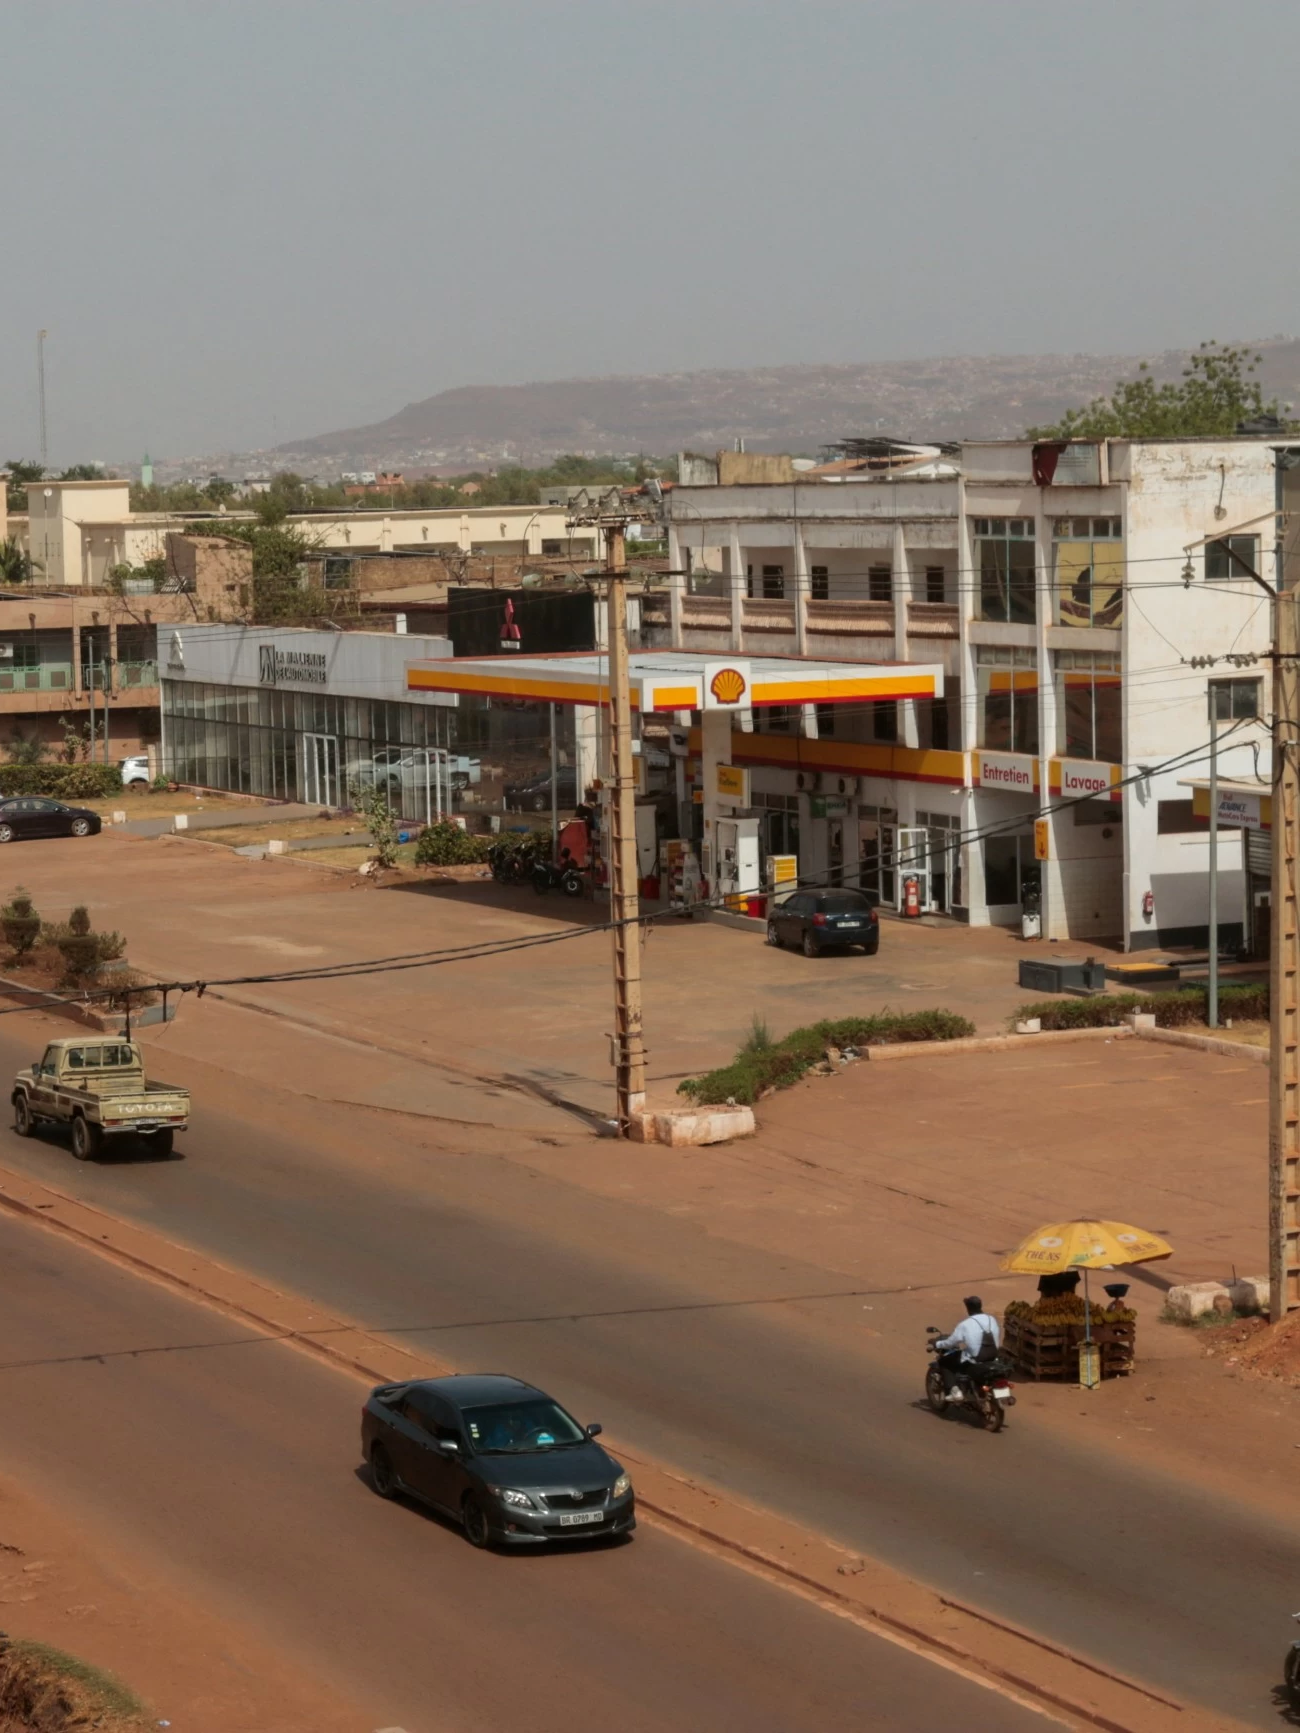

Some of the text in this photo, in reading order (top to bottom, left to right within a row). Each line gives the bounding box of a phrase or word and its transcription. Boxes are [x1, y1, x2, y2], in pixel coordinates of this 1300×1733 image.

[275, 651, 326, 668] LA MALIENNE
[275, 667, 326, 684] DE L'AUTOMOBILE
[983, 763, 1029, 785] Entretien
[1065, 771, 1106, 792] Lavage
[118, 1103, 173, 1113] TOYOTA
